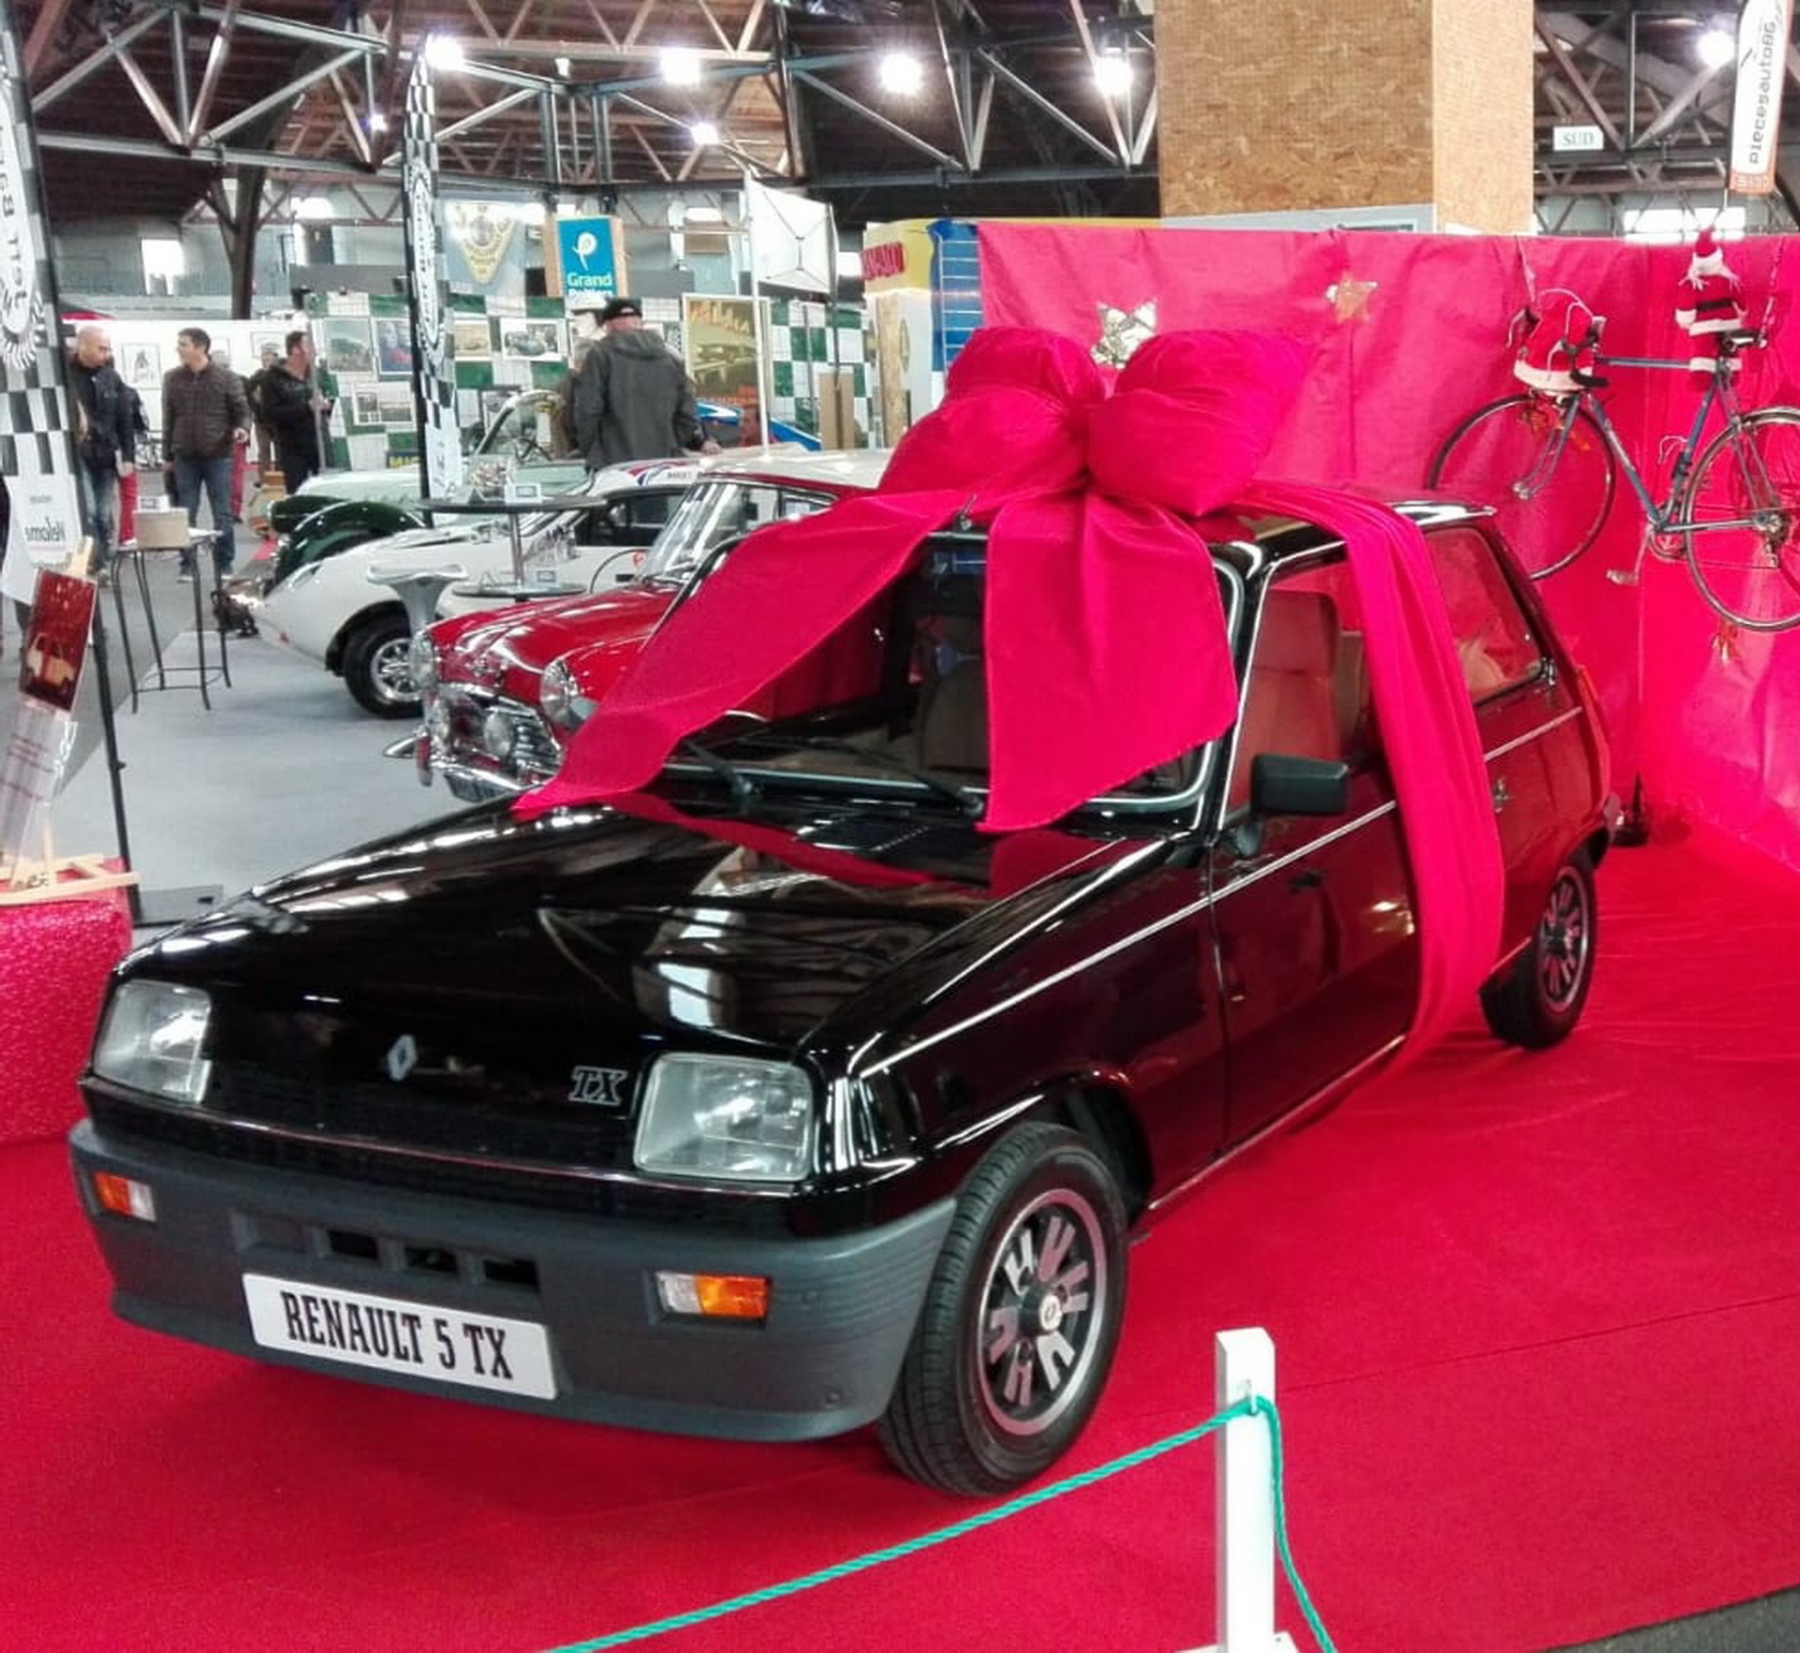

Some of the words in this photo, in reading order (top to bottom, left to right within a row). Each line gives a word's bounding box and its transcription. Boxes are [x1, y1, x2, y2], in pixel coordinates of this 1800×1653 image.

[1563, 132, 1595, 147] SUD
[567, 272, 612, 287] Grand
[280, 1290, 424, 1365] RENAULT
[433, 1318, 457, 1370] 5
[461, 1322, 514, 1381] TX
